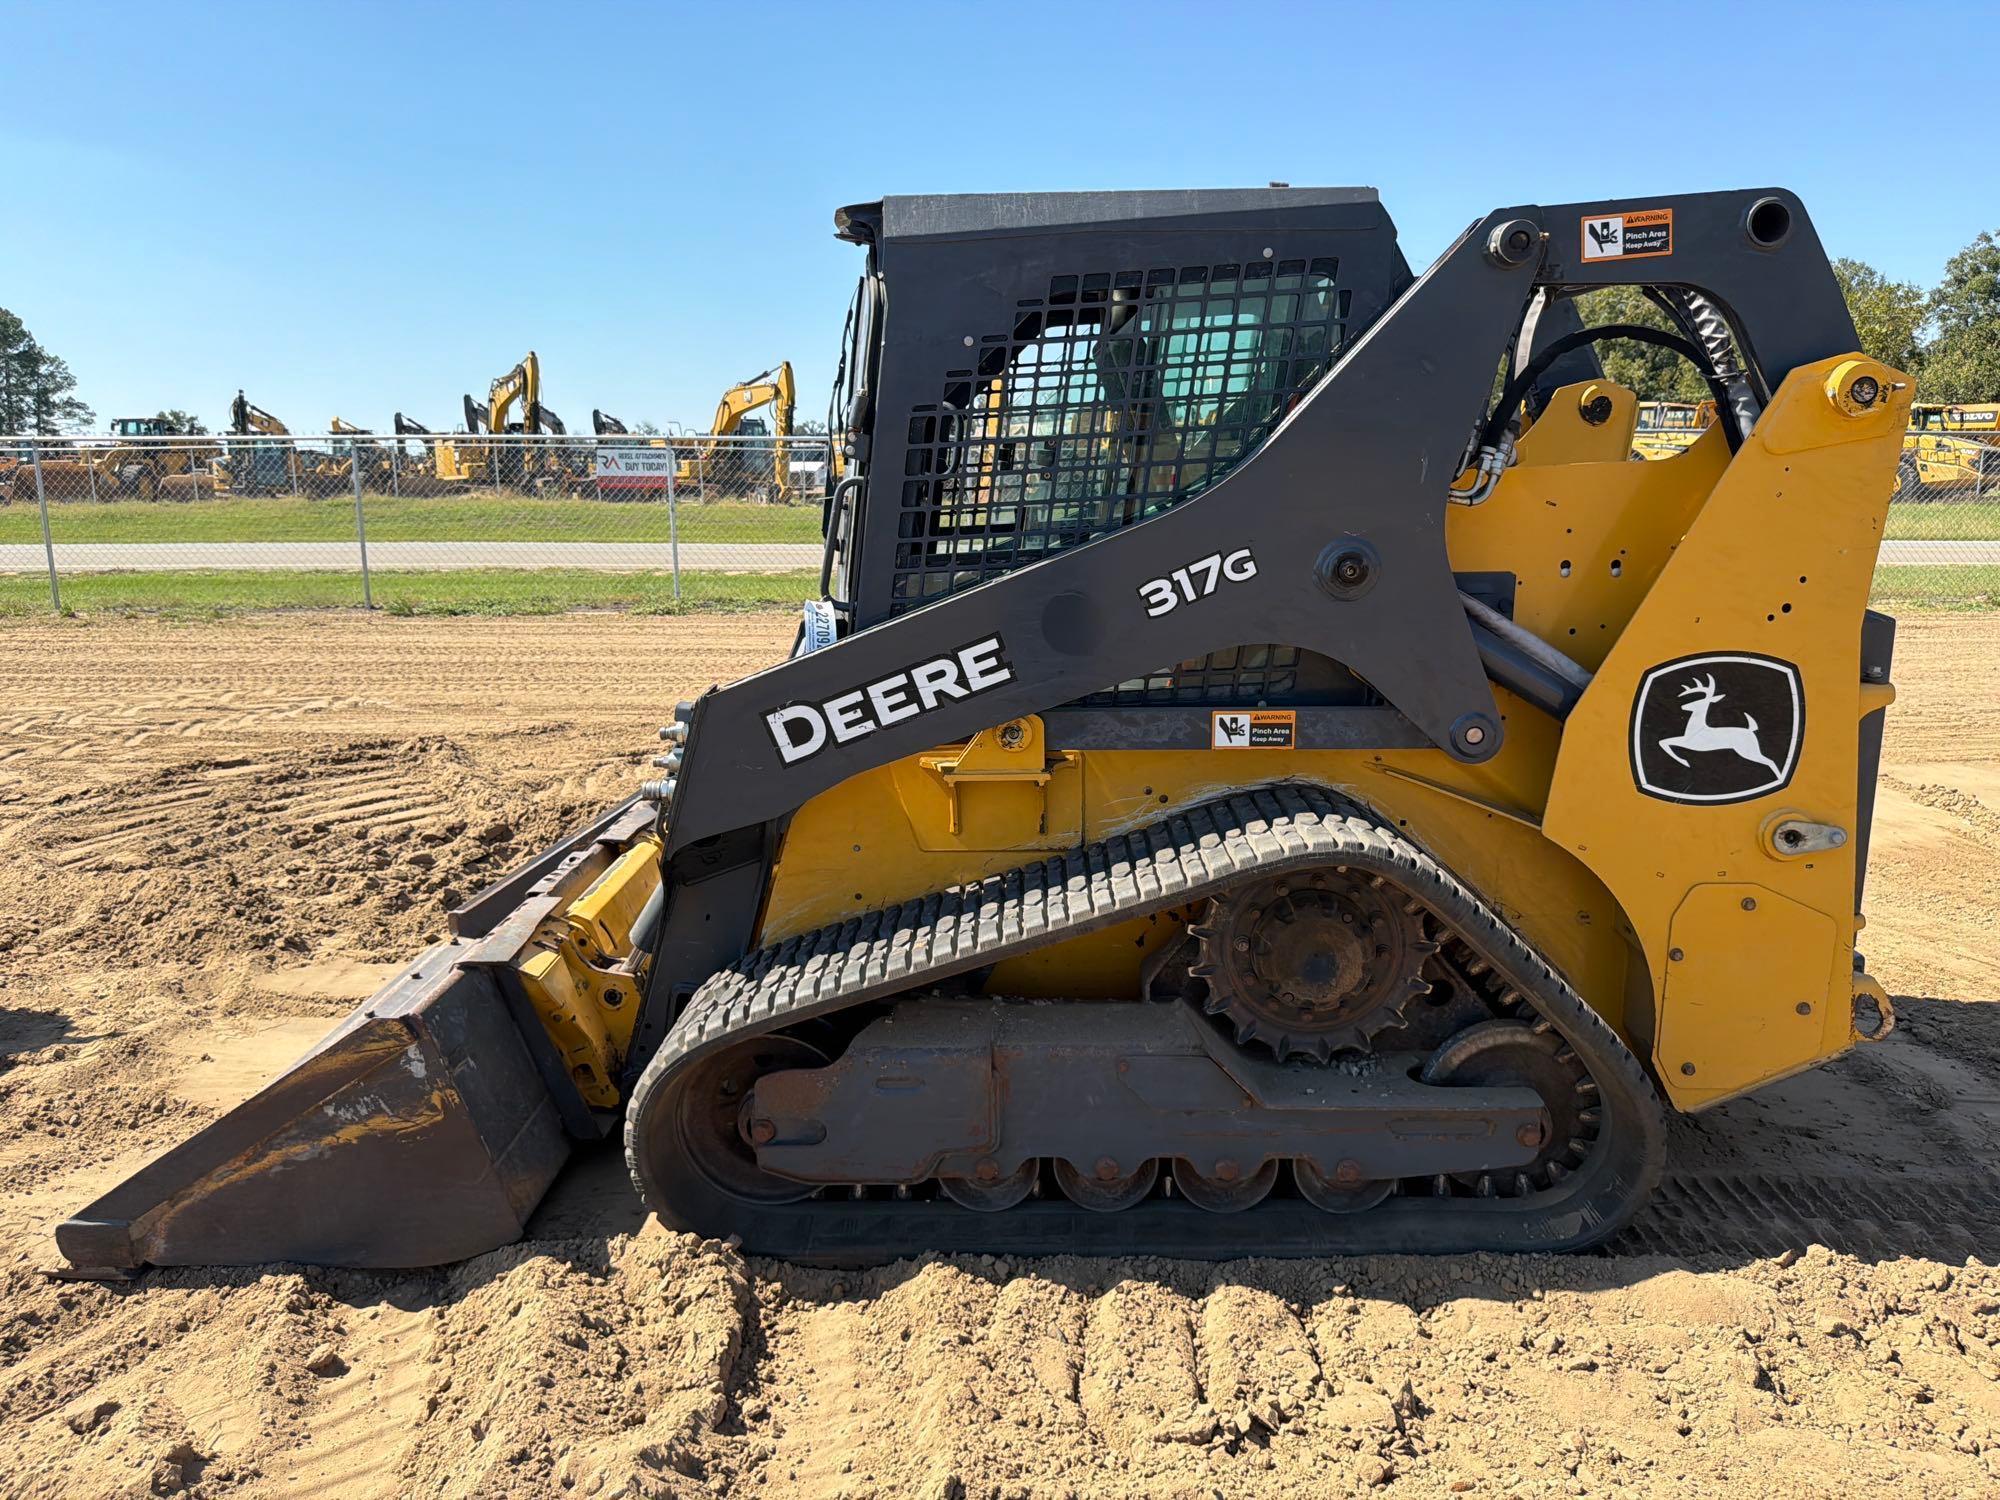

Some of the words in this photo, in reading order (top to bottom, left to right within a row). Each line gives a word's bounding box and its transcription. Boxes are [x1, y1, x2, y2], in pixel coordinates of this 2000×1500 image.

[1633, 213, 1669, 223] WARNING
[1625, 231, 1648, 240] Pinch
[1648, 230, 1667, 238] Area
[1643, 240, 1661, 248] Away
[1138, 548, 1258, 617] 317G
[766, 638, 1012, 763] DEERE
[1252, 727, 1272, 735] Pinch
[1273, 727, 1290, 735] Area
